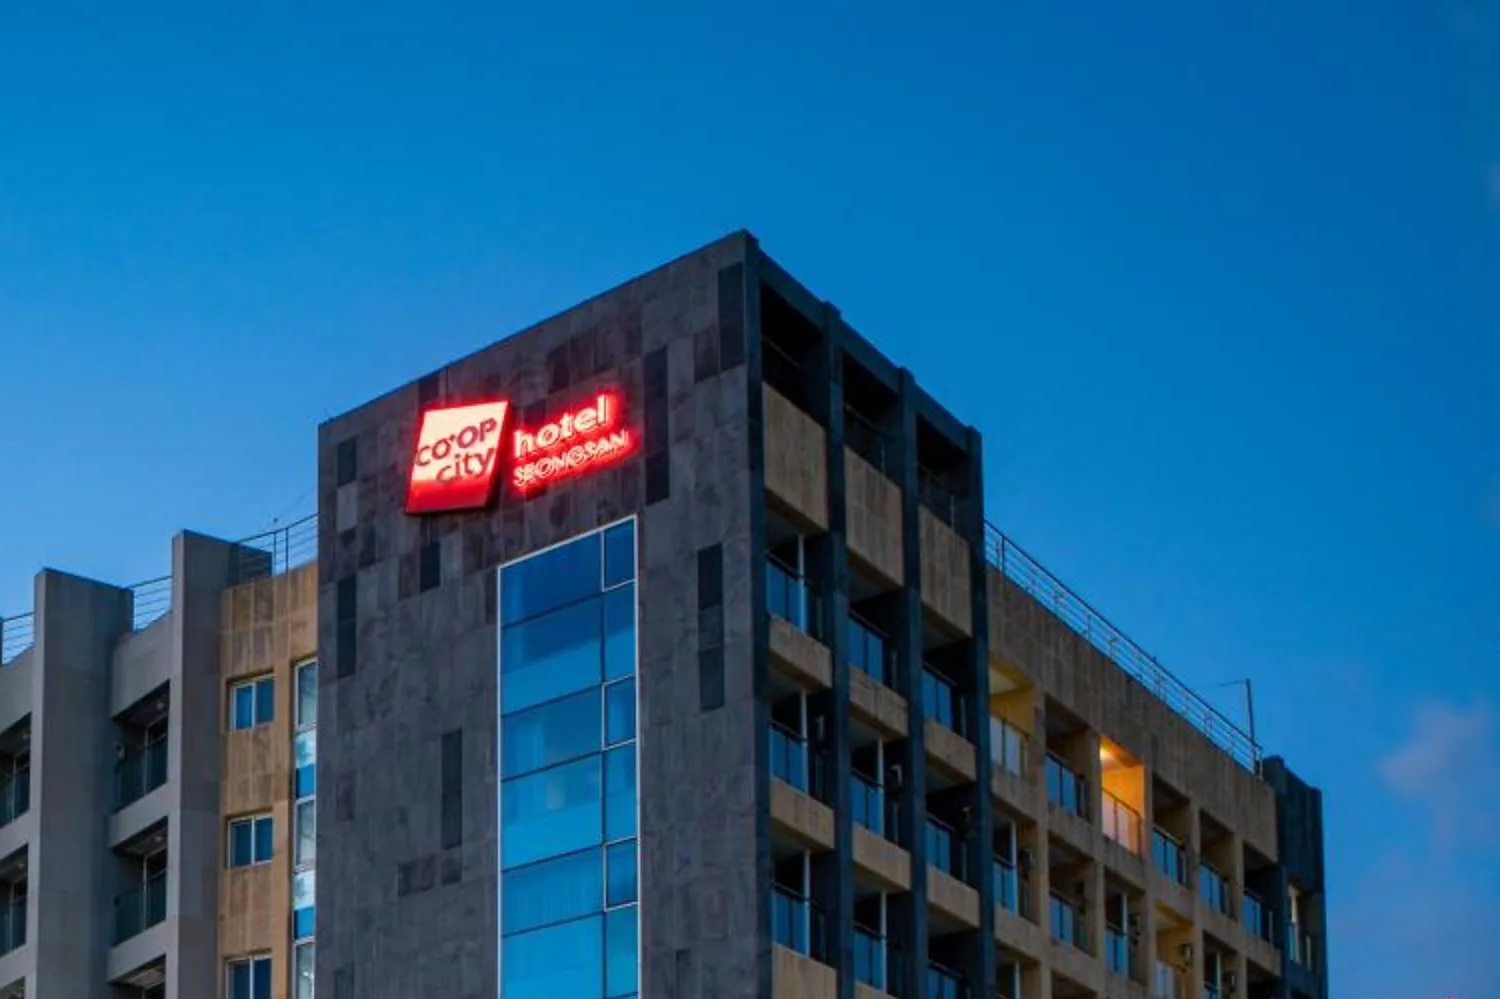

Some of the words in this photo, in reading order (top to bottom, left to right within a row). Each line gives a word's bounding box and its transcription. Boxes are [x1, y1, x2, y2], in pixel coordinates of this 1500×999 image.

[514, 395, 608, 458] hotel
[436, 447, 495, 483] city
[513, 429, 629, 487] SEONGSAN
